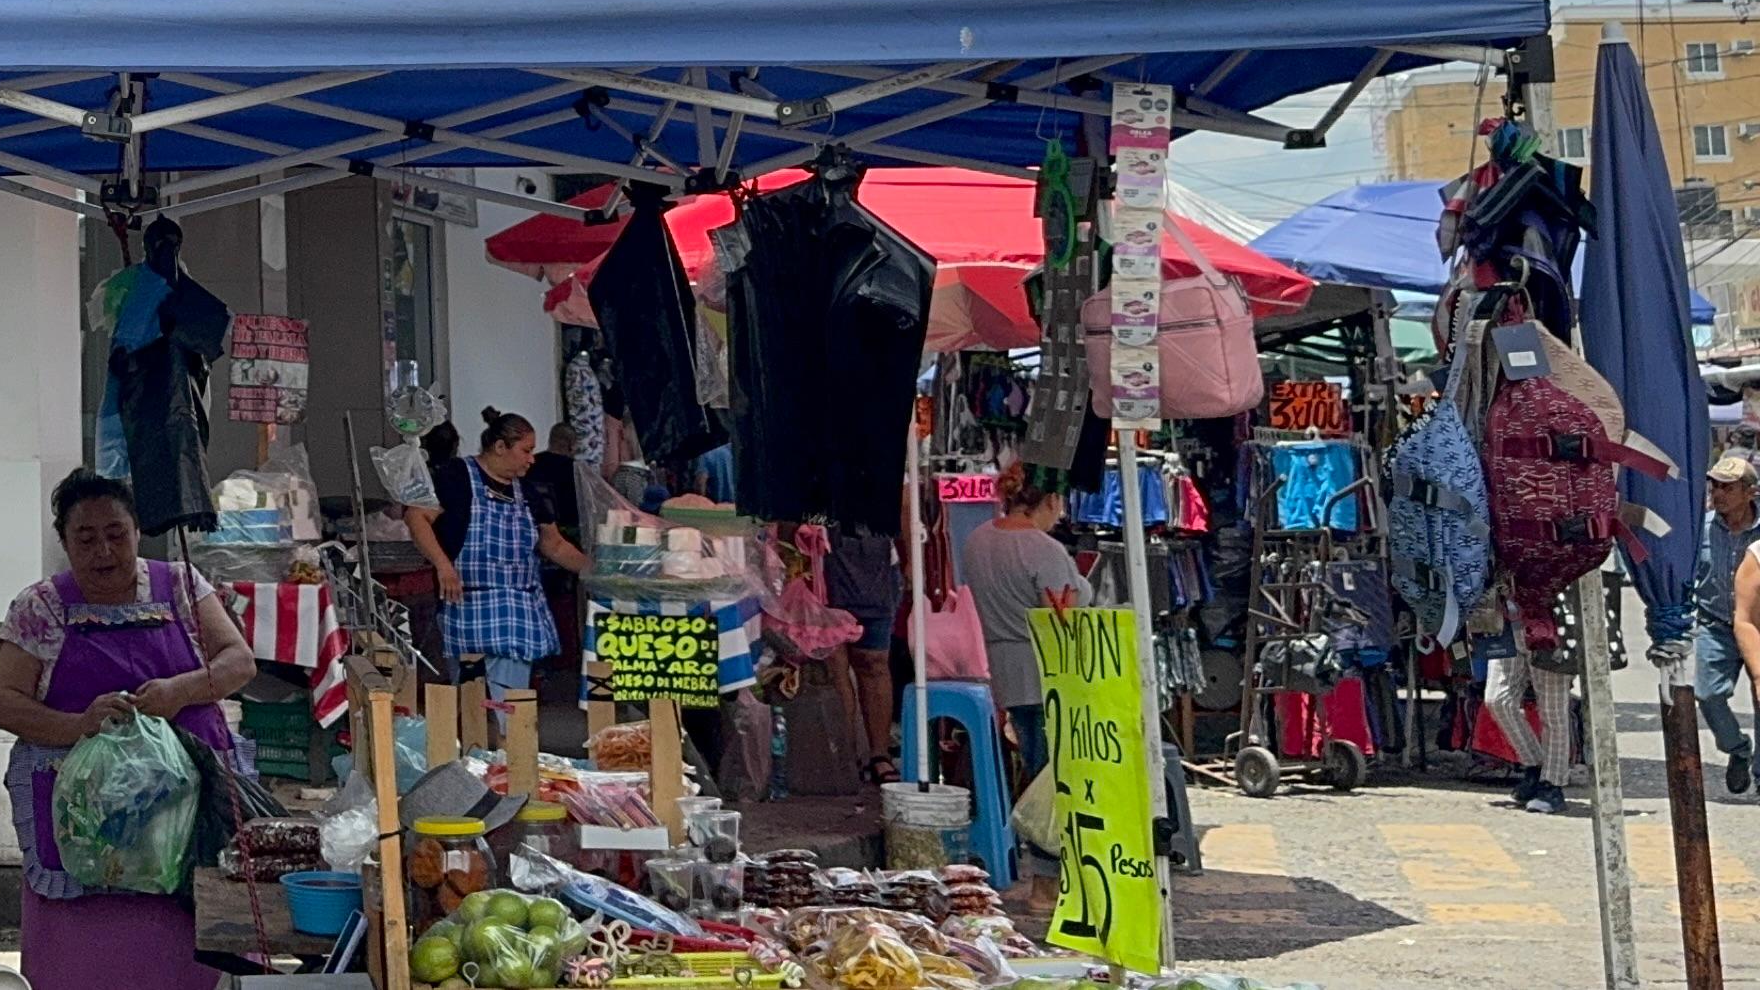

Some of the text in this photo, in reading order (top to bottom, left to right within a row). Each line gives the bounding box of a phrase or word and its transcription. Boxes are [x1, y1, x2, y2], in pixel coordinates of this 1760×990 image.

[606, 615, 707, 635] SABROSO
[596, 632, 718, 660] QUESO DE
[613, 673, 654, 687] UESO
[666, 660, 718, 676] ARO
[1044, 688, 1071, 796] 2
[1110, 843, 1154, 879] Pesos
